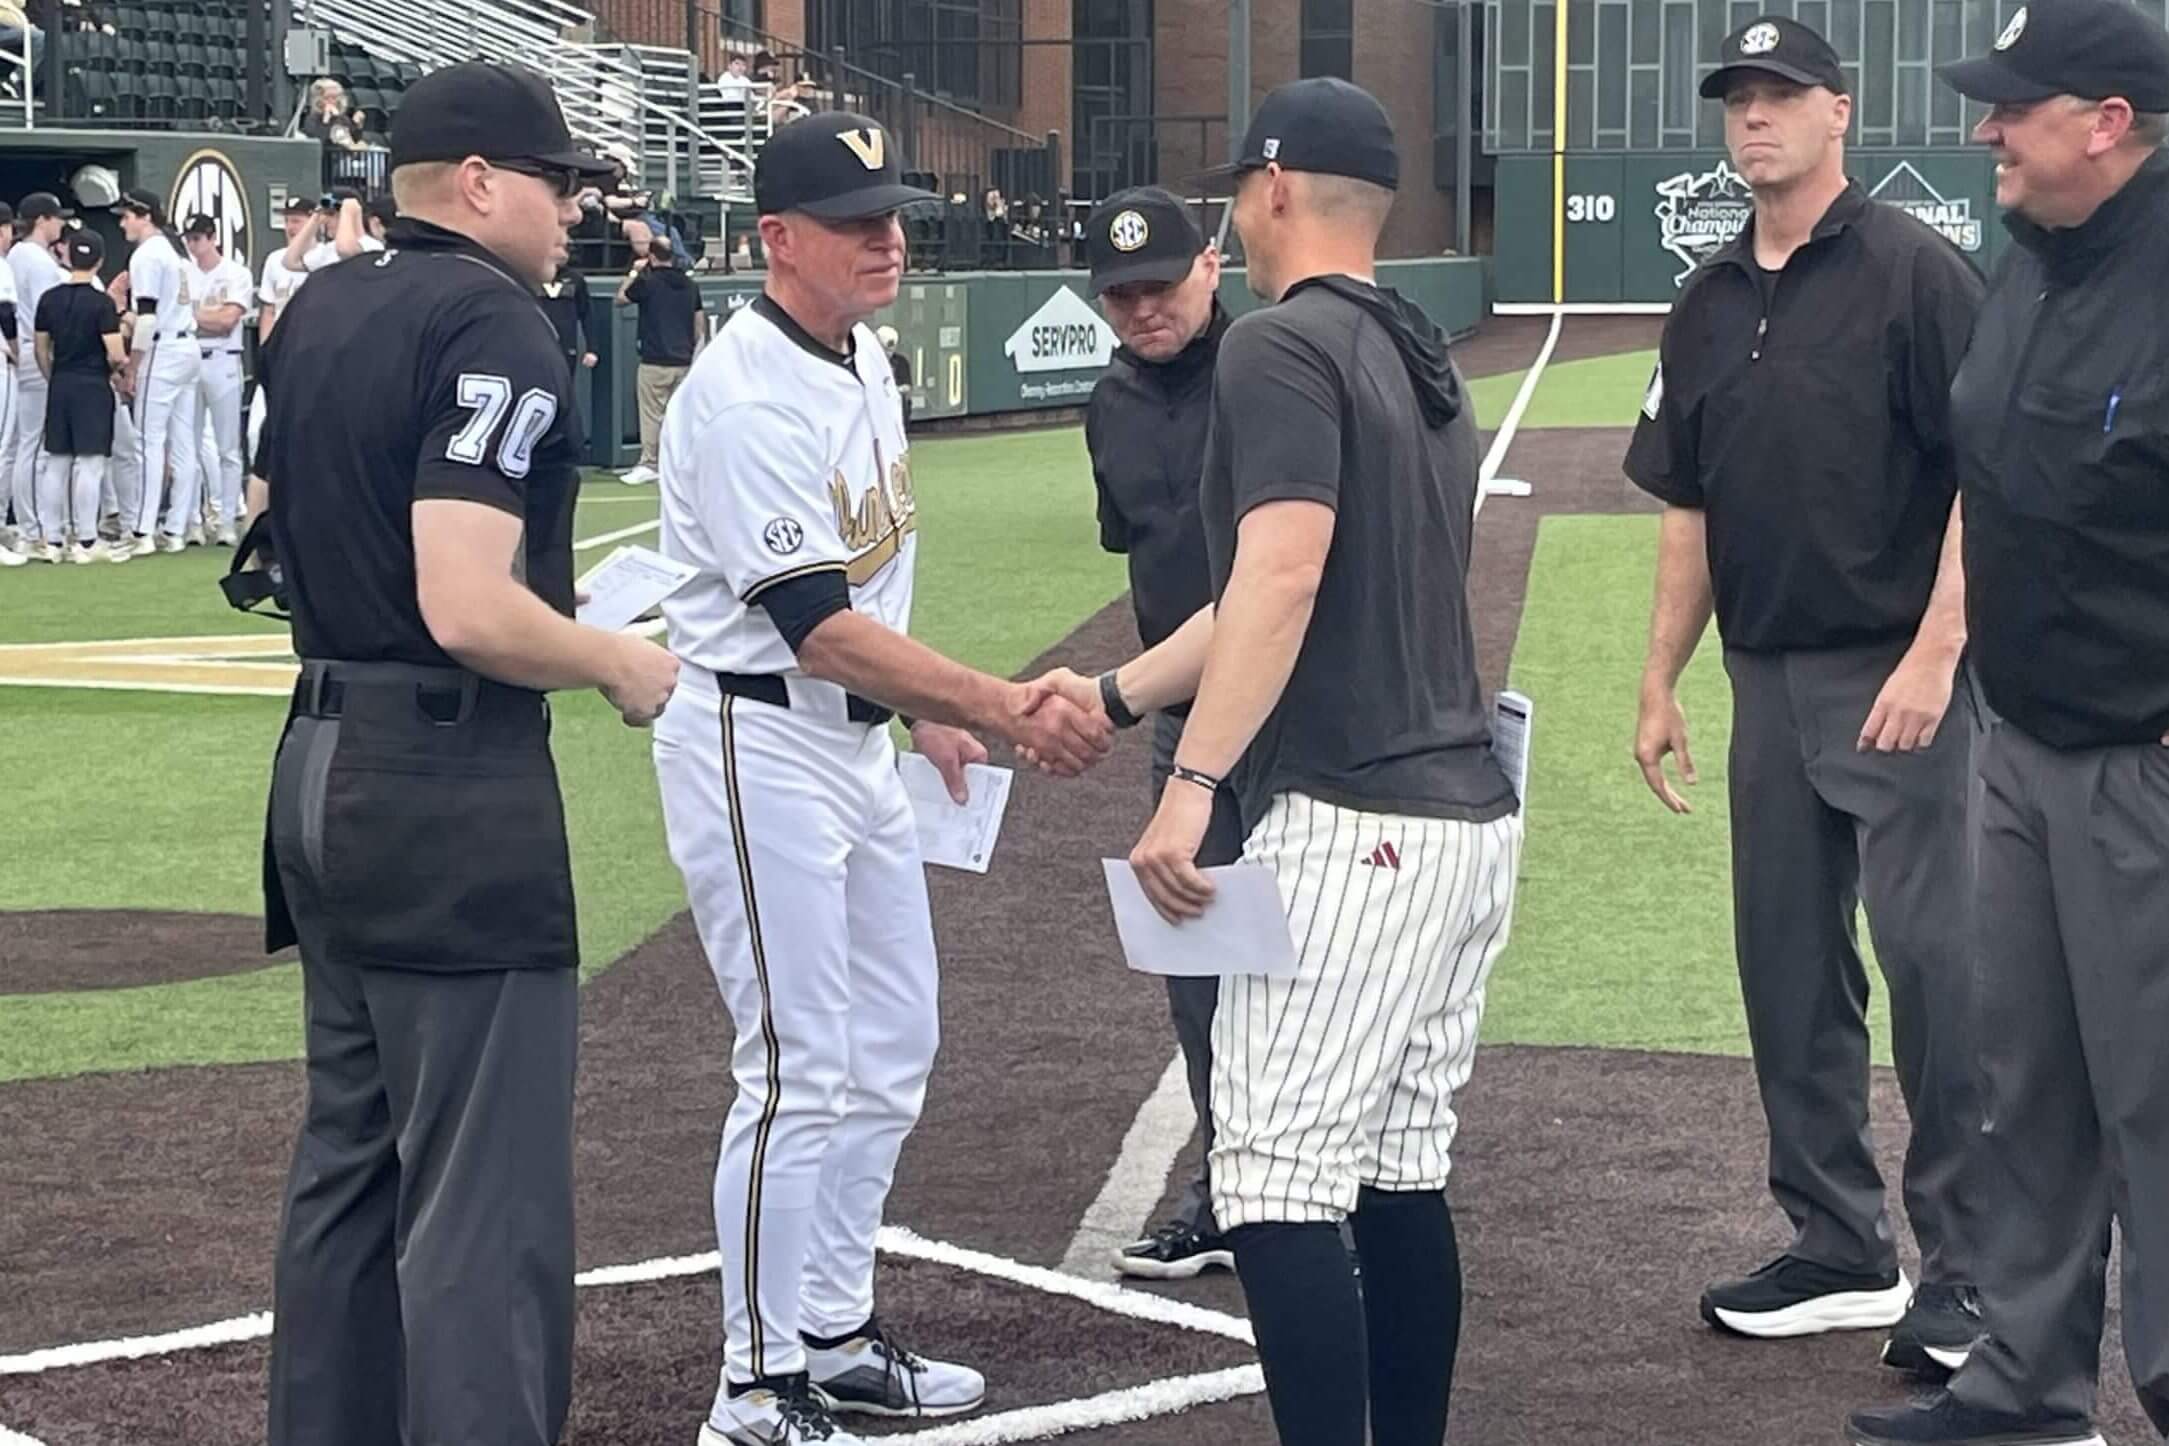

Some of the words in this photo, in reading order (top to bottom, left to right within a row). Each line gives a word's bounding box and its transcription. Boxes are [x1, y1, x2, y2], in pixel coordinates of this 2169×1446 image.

[836, 128, 884, 170] V
[1567, 195, 1615, 221] 310
[1112, 211, 1148, 250] SEC
[1032, 323, 1097, 358] SERVPRO
[445, 373, 557, 479] 70
[764, 517, 804, 555] SEC
